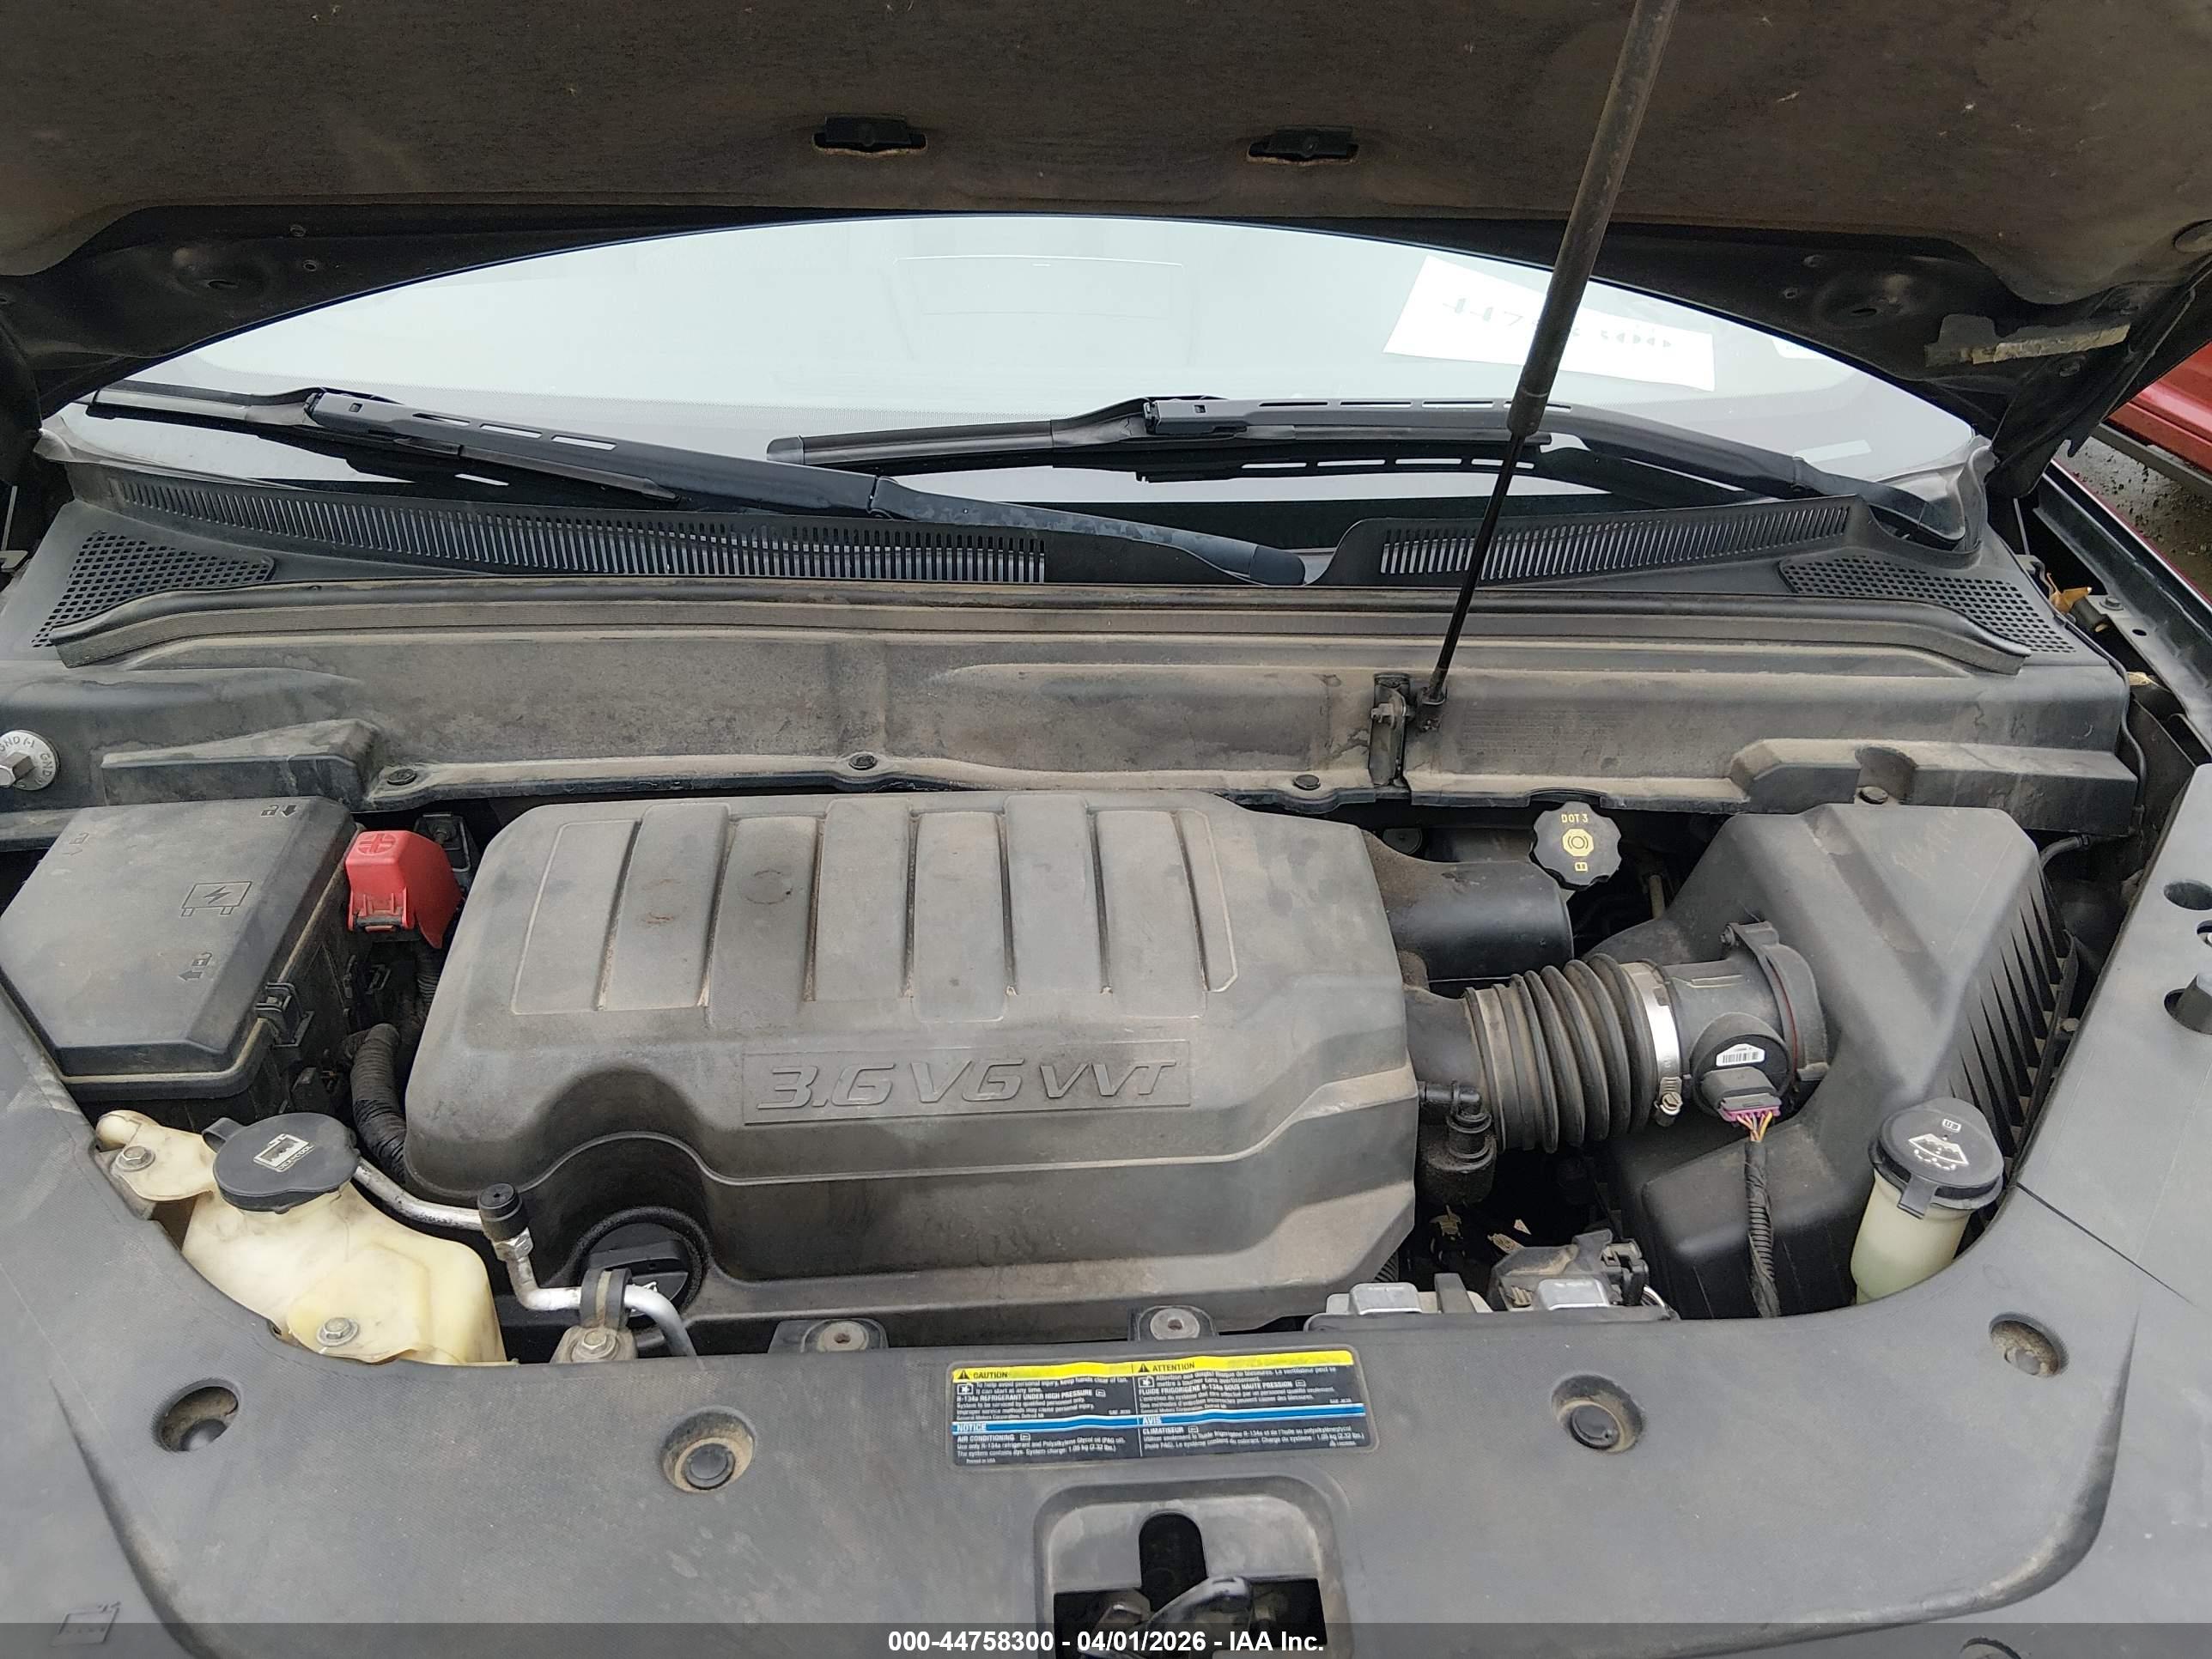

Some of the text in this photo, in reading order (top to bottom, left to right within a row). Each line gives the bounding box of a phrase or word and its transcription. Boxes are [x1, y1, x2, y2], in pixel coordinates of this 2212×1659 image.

[1561, 814, 1589, 823] DOT 3
[911, 1058, 1024, 1103] V6
[1040, 1061, 1176, 1098] VVT
[1152, 1362, 1195, 1372] ATTENTION
[1262, 1380, 1292, 1389] PRESSION
[1061, 1389, 1092, 1398] PRESSURE
